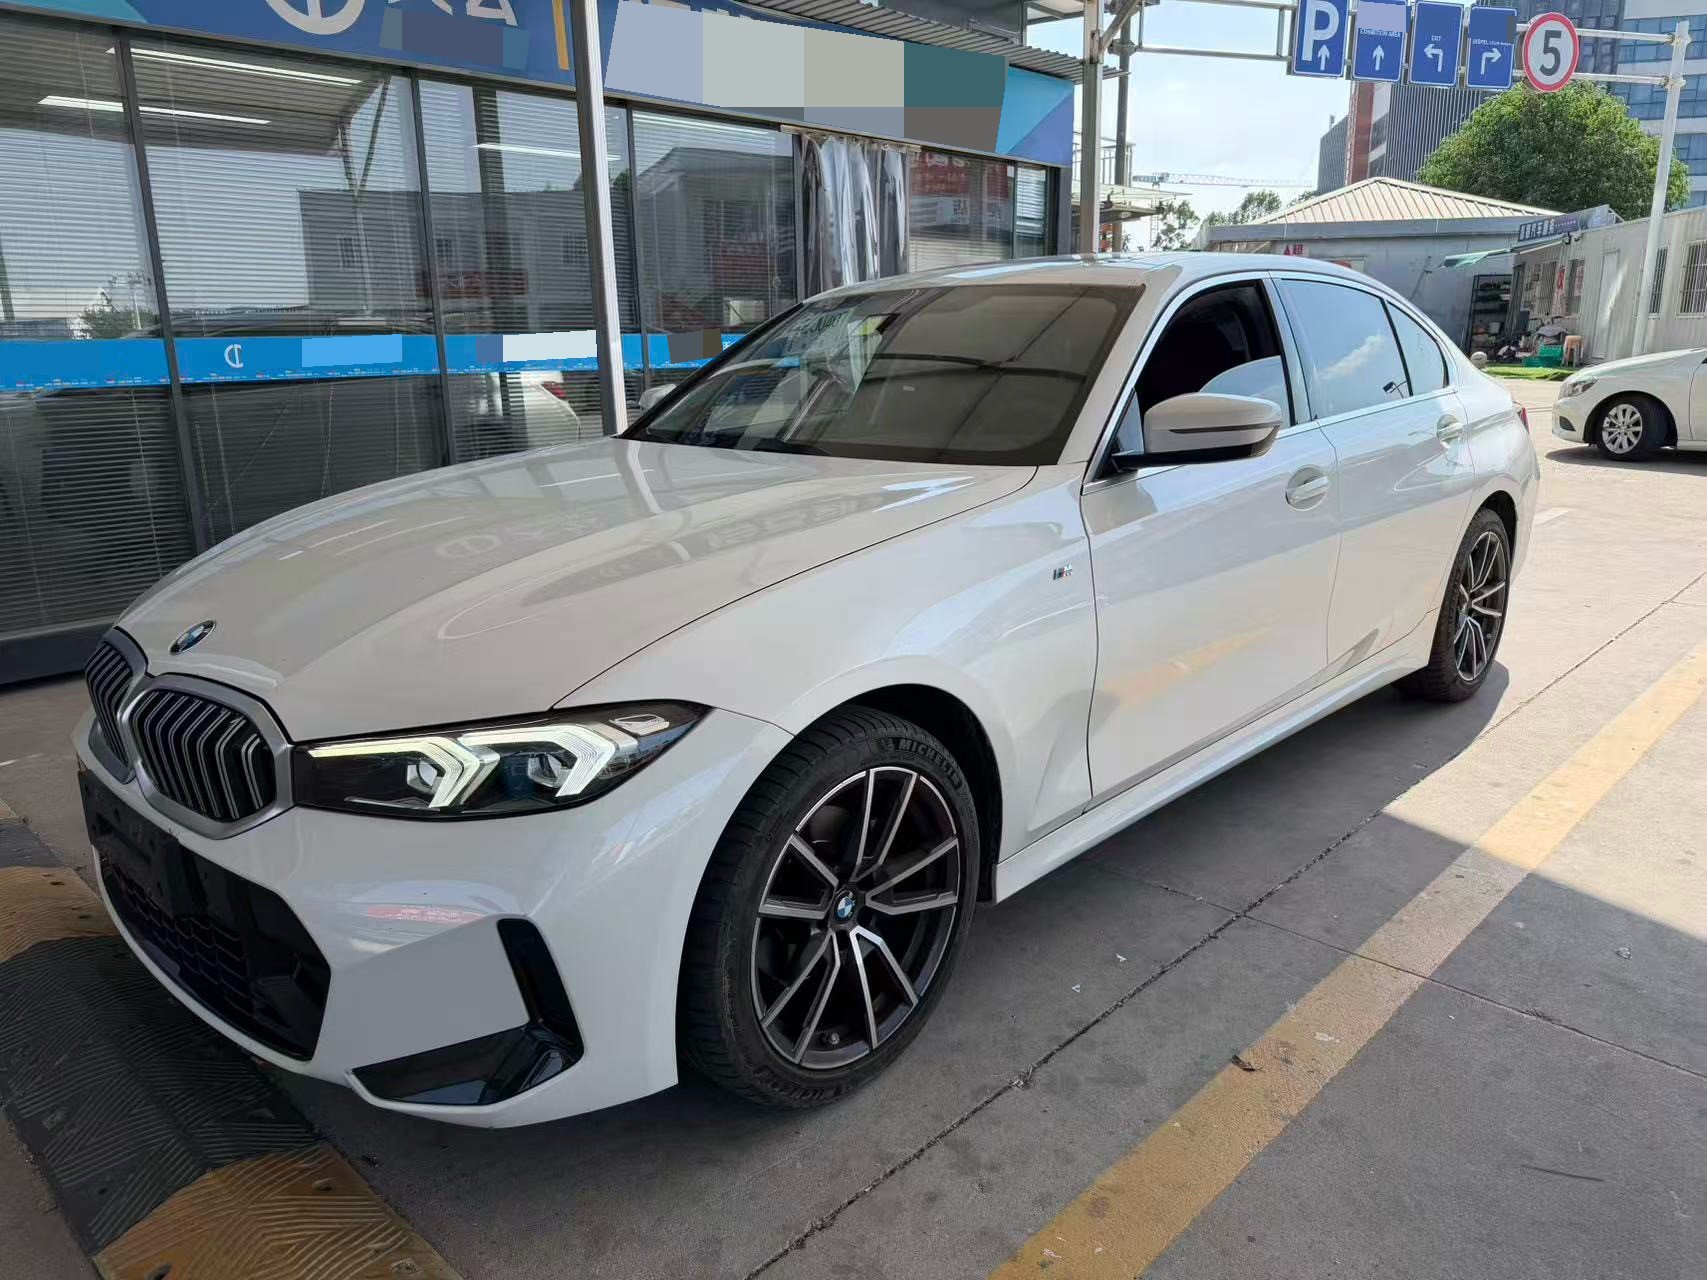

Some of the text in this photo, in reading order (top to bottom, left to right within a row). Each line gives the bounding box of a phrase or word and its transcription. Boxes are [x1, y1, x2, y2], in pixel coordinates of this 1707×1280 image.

[1302, 0, 1340, 61] P
[1539, 30, 1562, 76] 5
[898, 738, 962, 788] MICHELIN
